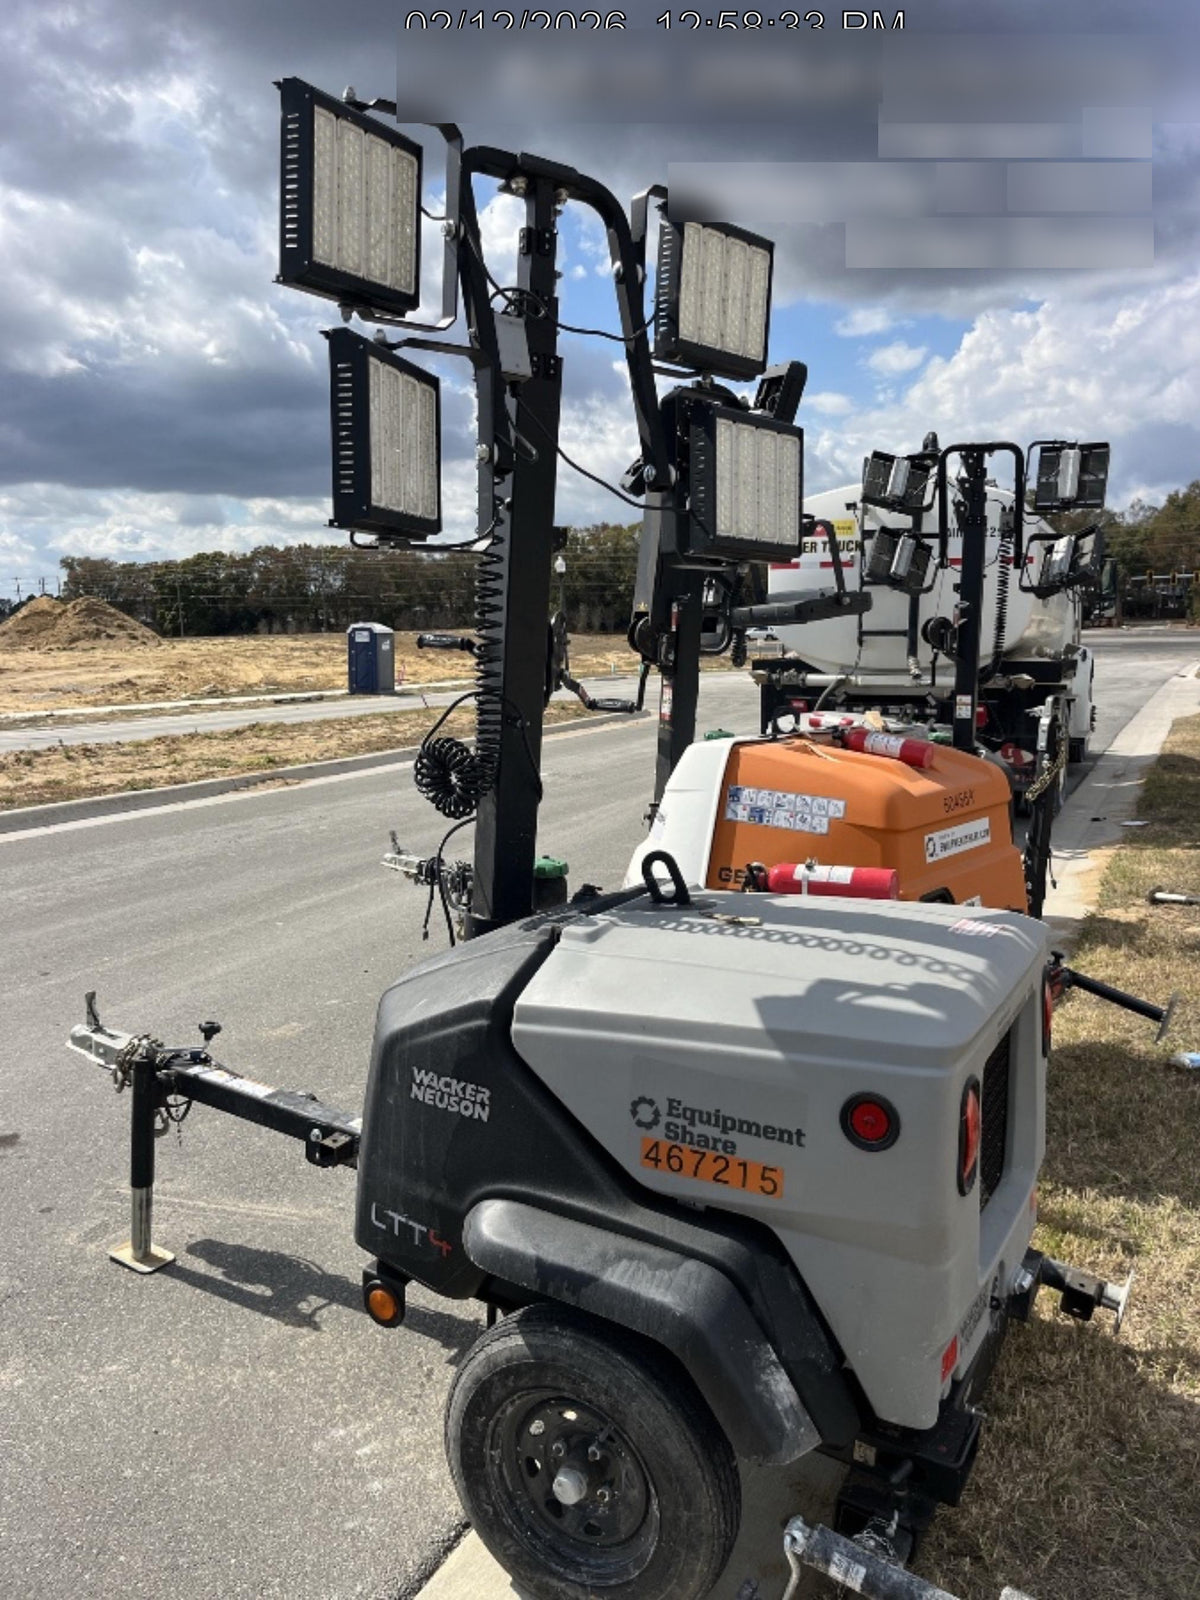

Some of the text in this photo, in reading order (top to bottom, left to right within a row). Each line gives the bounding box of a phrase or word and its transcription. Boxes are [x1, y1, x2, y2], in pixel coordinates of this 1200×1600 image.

[410, 1085, 491, 1123] NEUSON
[412, 1066, 492, 1104] WACKER
[664, 1122, 738, 1156] Share
[666, 1097, 807, 1149] Equipment
[643, 1139, 779, 1197] 467215
[370, 1202, 453, 1258] LTT4
